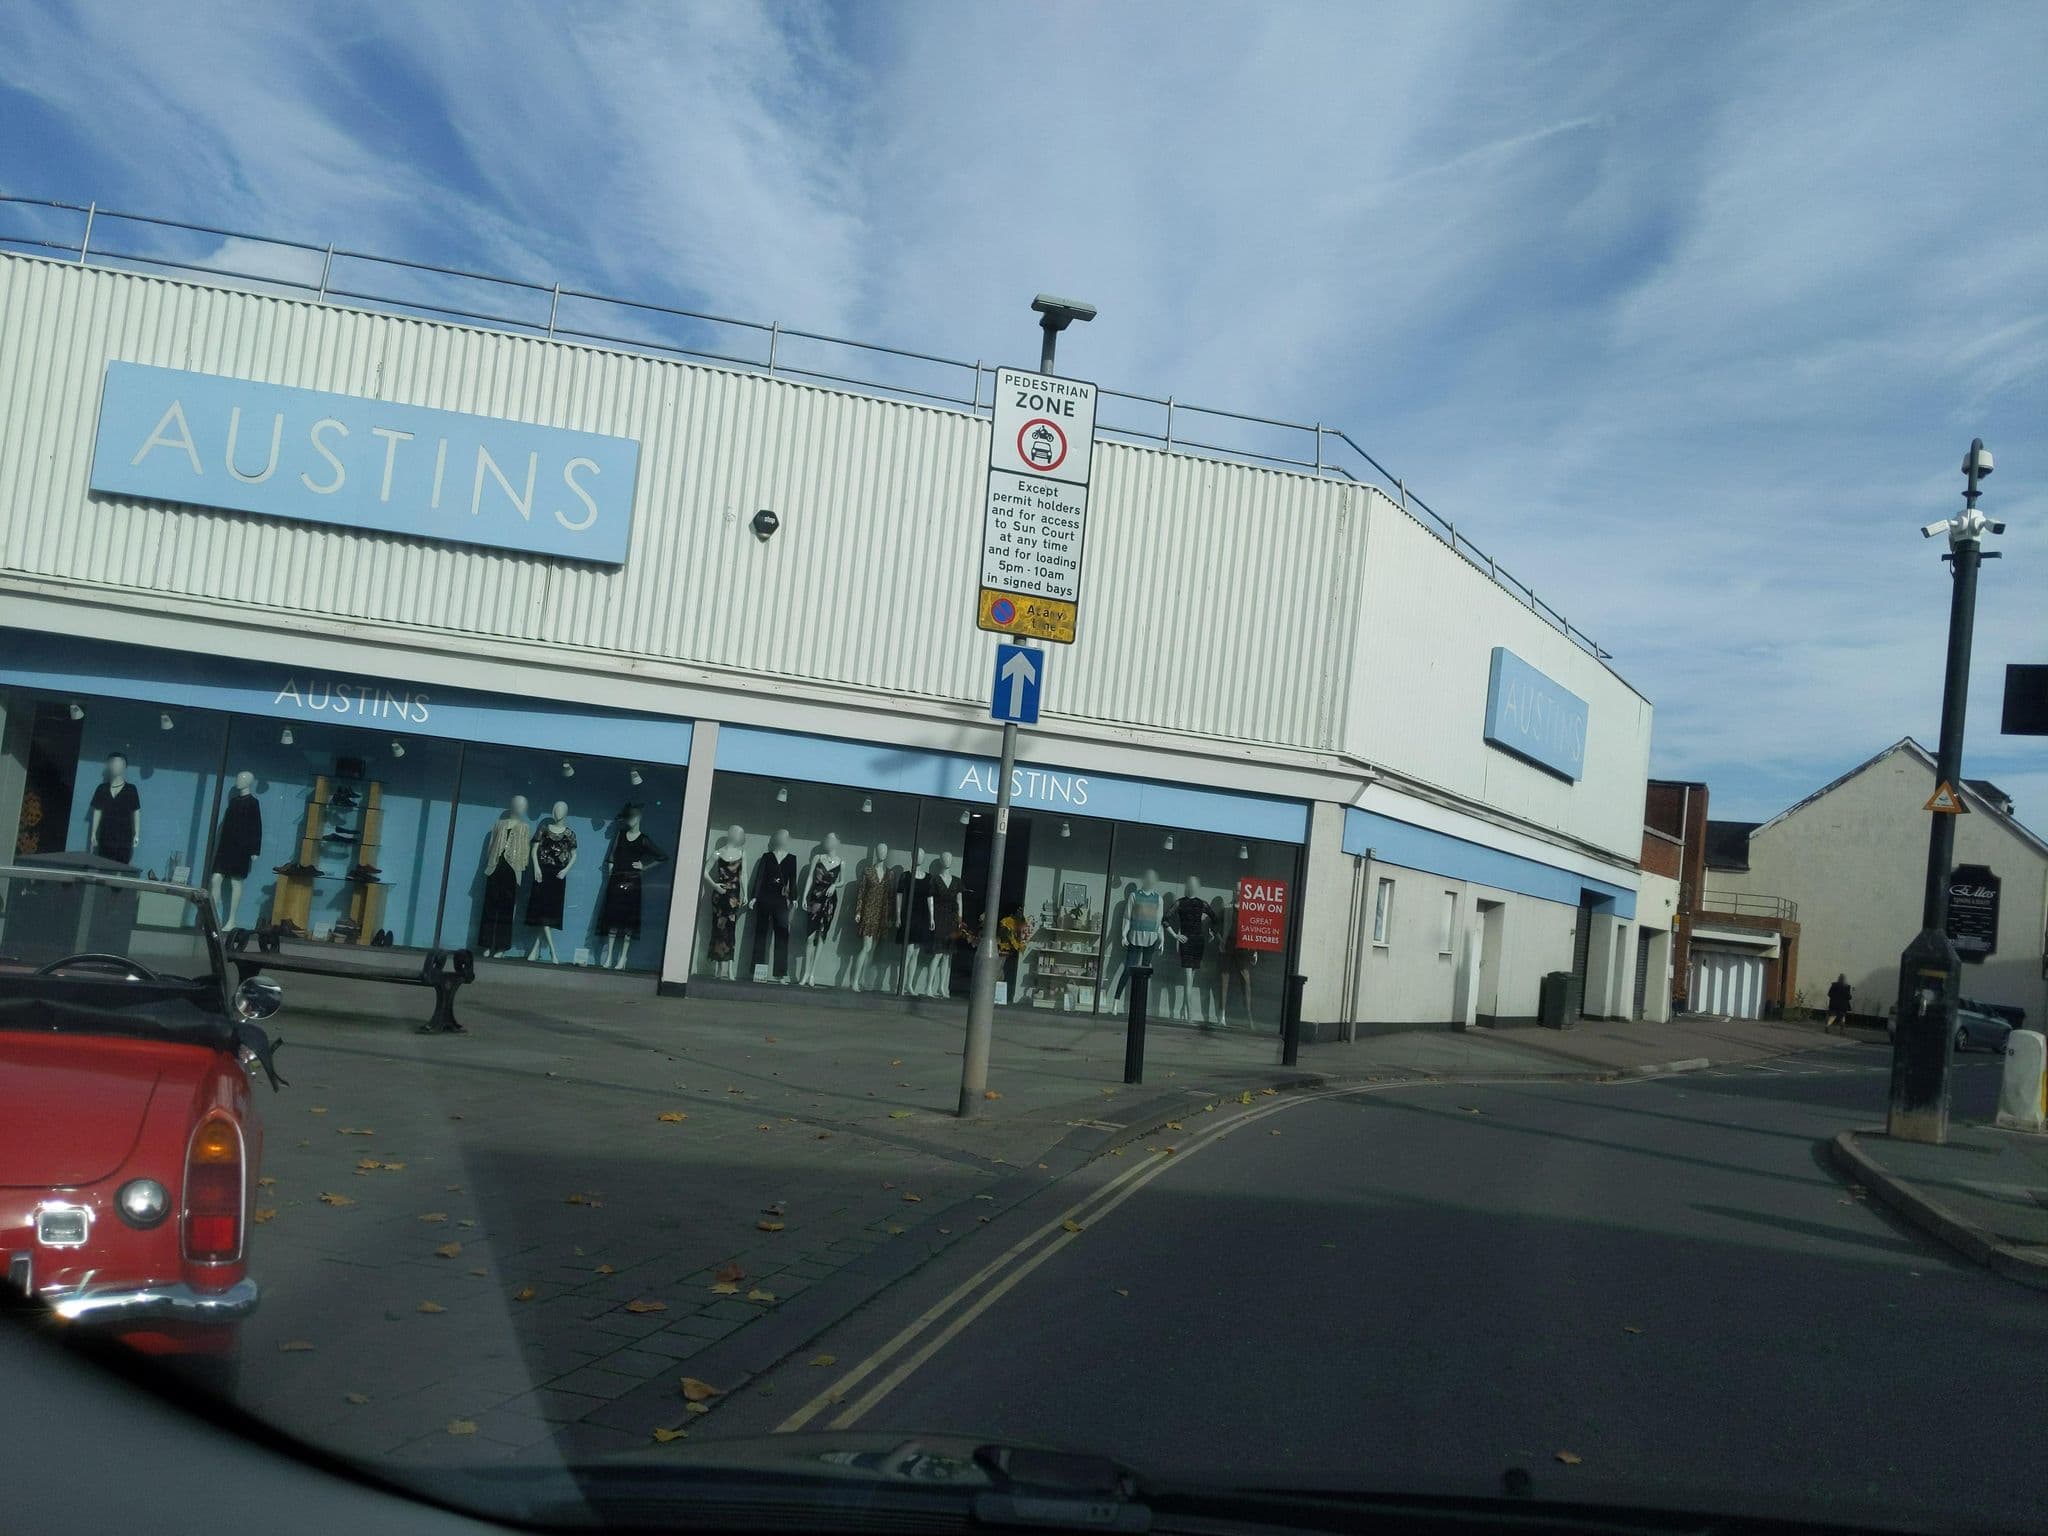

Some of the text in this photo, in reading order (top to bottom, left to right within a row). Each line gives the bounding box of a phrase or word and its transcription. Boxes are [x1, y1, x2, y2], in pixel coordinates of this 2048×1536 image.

[1005, 374, 1089, 399] PEDESTRIAN
[1015, 391, 1075, 418] ZONE
[130, 399, 601, 532] AUSTINS
[1018, 480, 1059, 498] Except
[993, 492, 1081, 515] permit holders
[991, 506, 1080, 530] and for access
[995, 518, 1075, 541] to Sun Court
[999, 532, 1068, 552] at any time
[988, 546, 1077, 570] and for loading
[999, 560, 1024, 574] 5pm
[1034, 566, 1065, 581] 10am
[987, 572, 1073, 597] in signed bays
[1032, 618, 1056, 632] tme
[274, 677, 430, 723] AUSTINS
[1503, 679, 1584, 762] AUSTINS
[958, 765, 1089, 805] AUSTINS
[1243, 884, 1284, 902] SALE
[1242, 901, 1283, 913] NOW ON
[1241, 925, 1271, 935] SAVINGS
[1249, 917, 1273, 926] GREAT
[1242, 934, 1280, 944] ALL STORES
